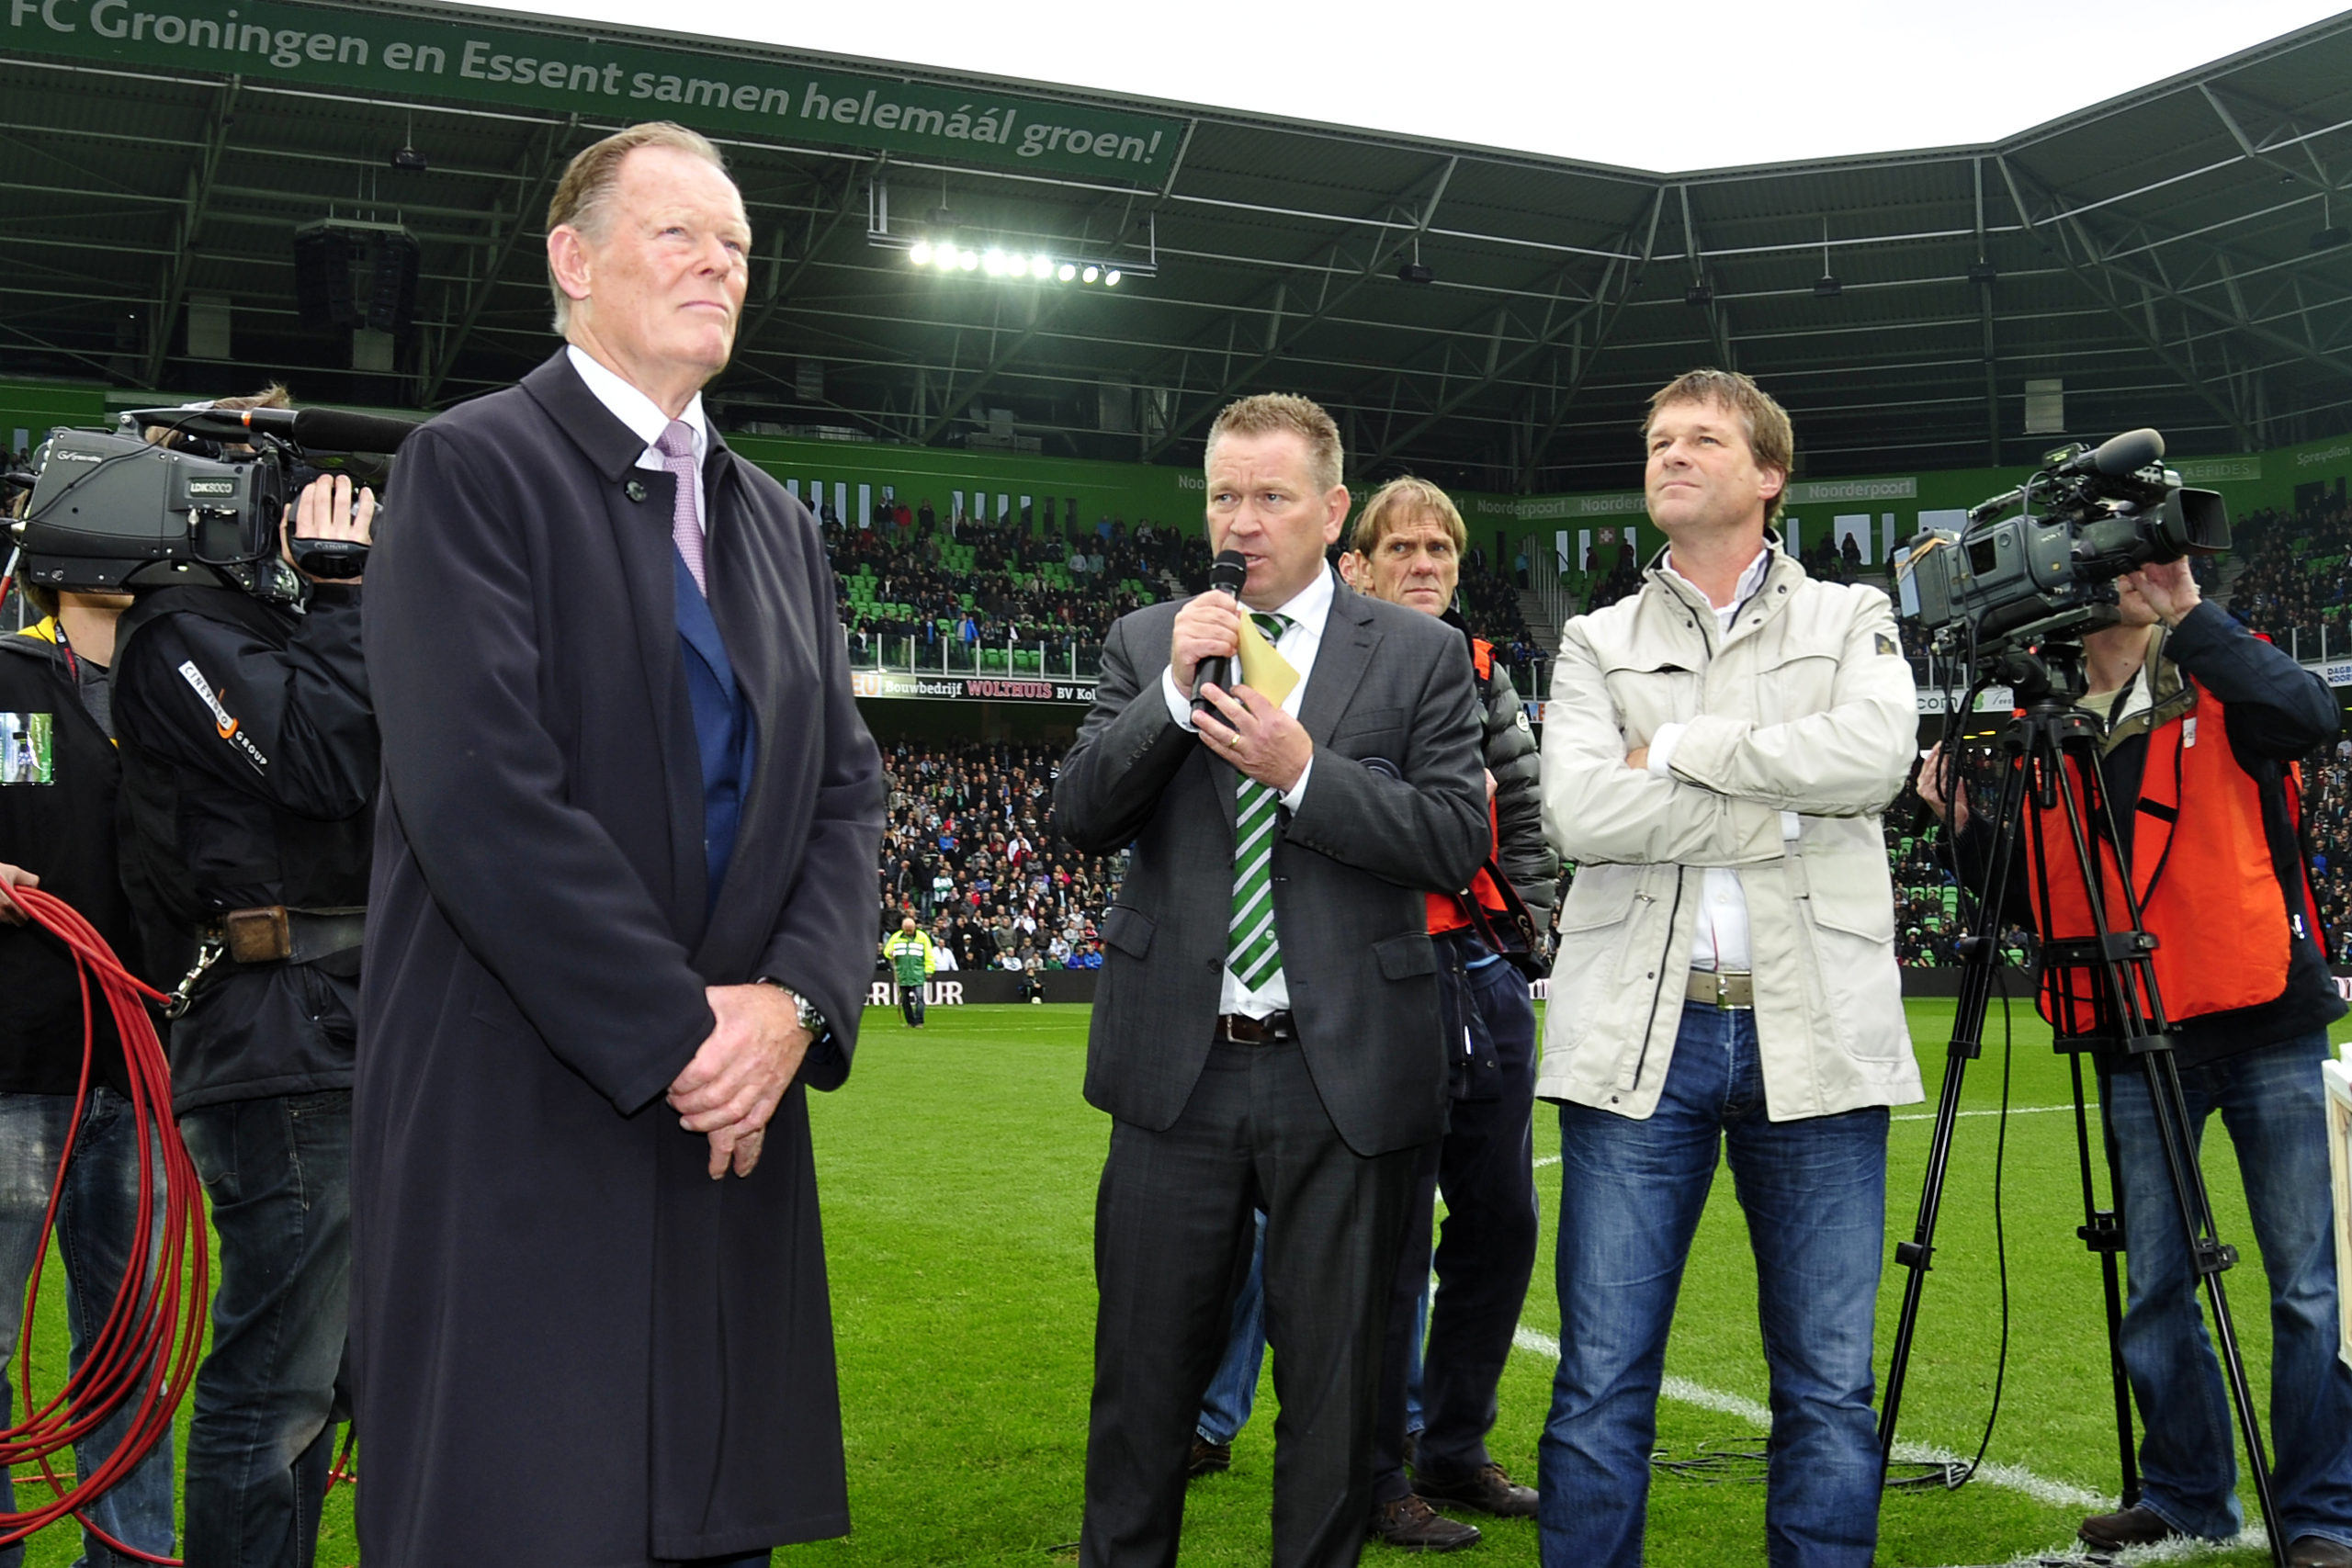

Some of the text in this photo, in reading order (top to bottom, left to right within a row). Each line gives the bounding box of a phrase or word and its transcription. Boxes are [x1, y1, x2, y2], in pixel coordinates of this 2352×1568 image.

[10, 0, 1163, 164] FC Groningen en Essent samen helemáál groen!
[1808, 479, 1912, 499] Noorderpoort
[1476, 498, 1566, 517] Noorderpoort
[313, 541, 349, 551] Canon
[884, 680, 964, 698] Bouwbedrijf
[966, 680, 1053, 699] WOLTHUIS
[1057, 687, 1074, 700] BV
[184, 665, 268, 765] CINEVIDEO GROUP
